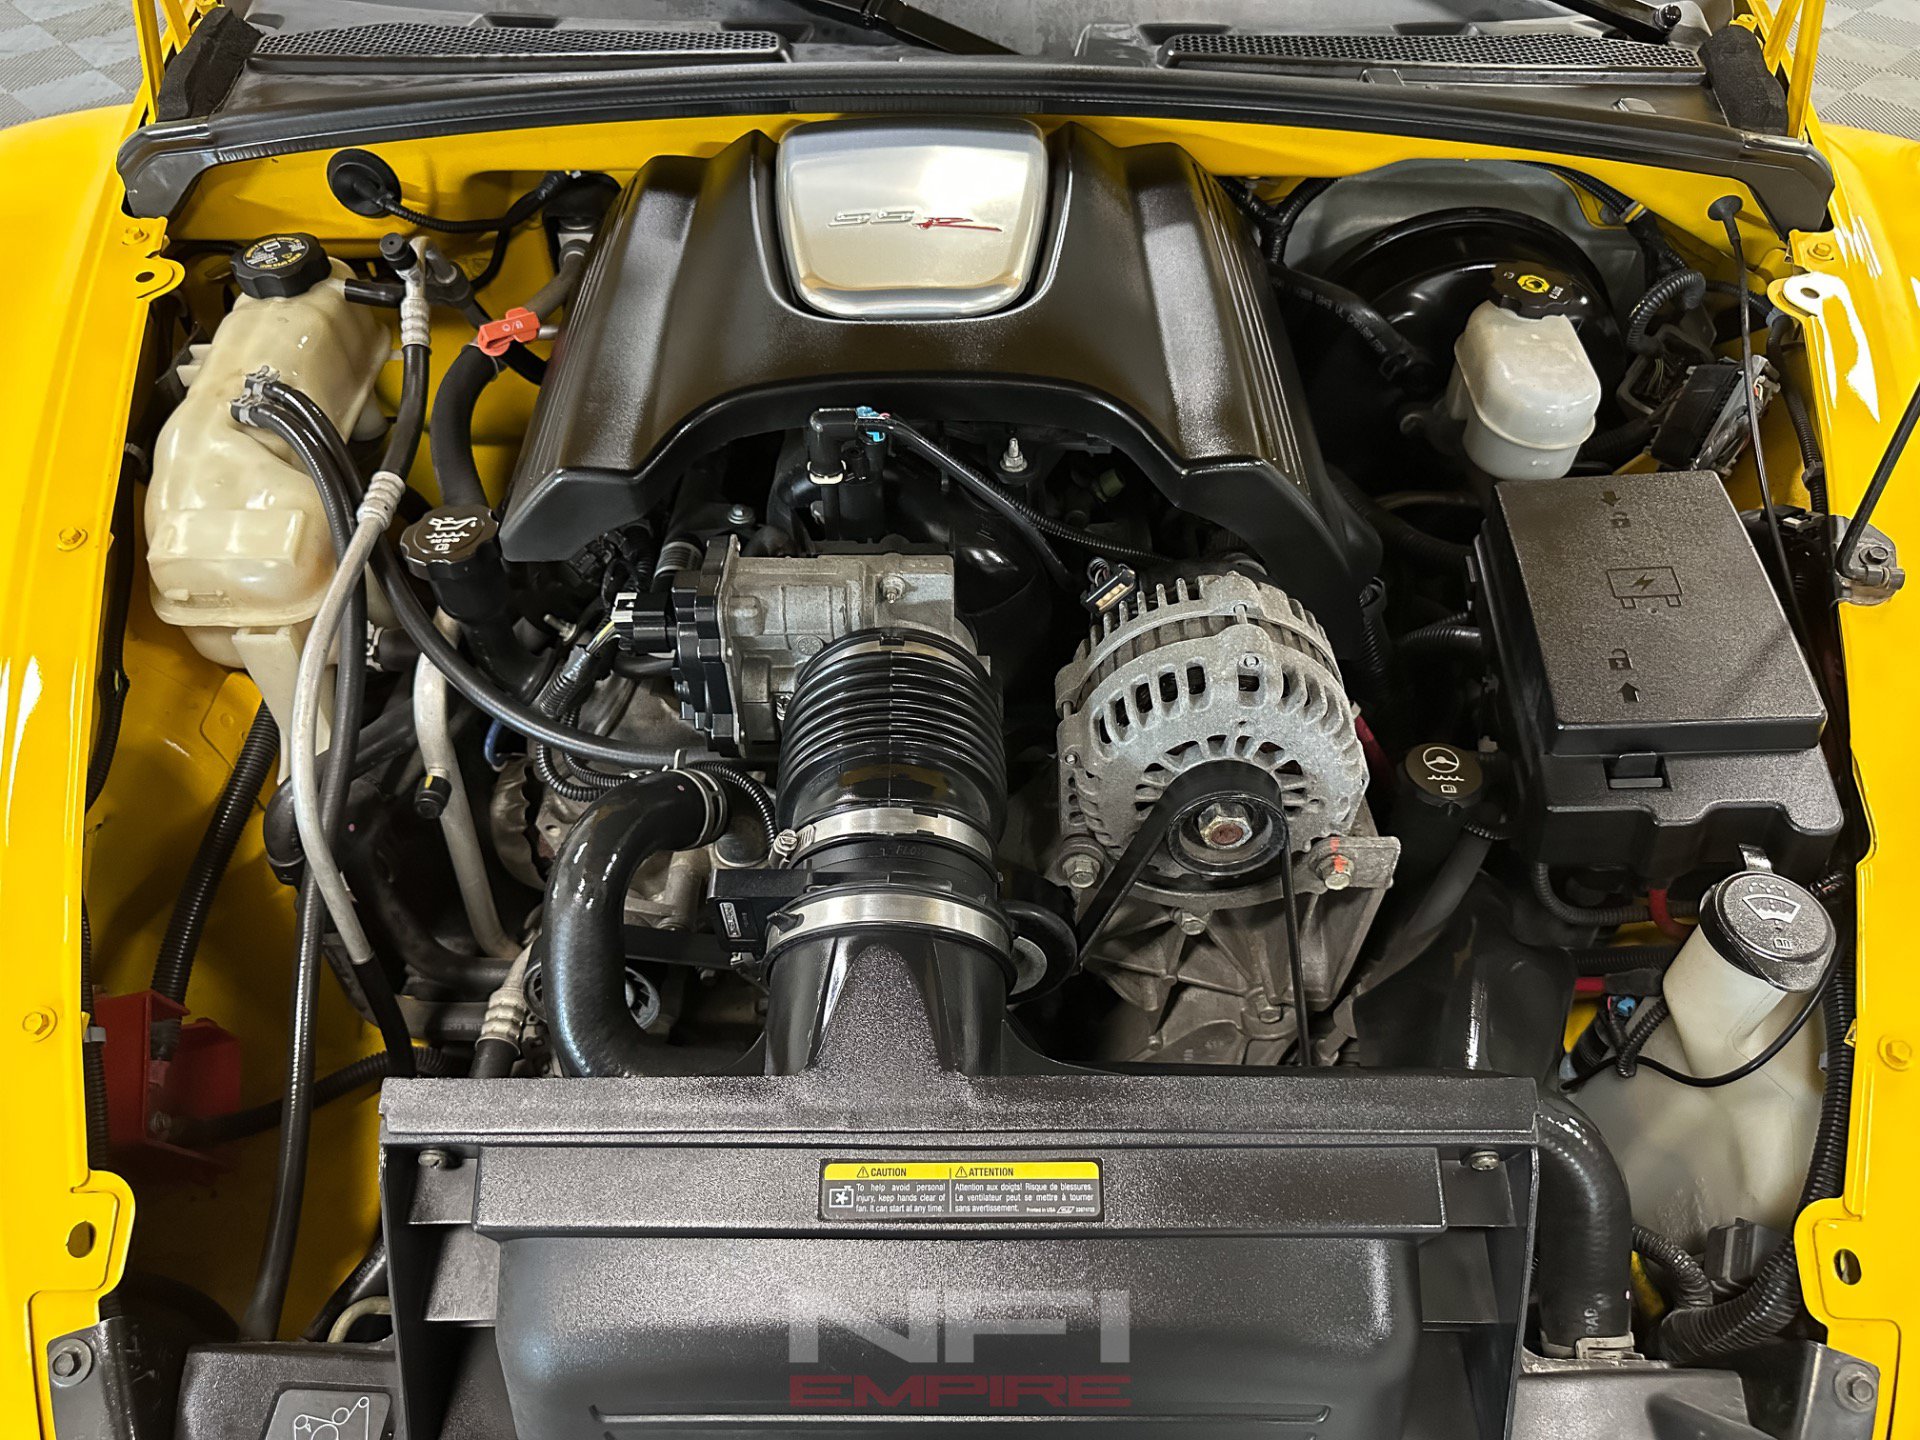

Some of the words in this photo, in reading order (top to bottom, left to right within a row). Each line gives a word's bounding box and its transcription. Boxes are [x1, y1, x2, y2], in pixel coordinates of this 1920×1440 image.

[828, 207, 1003, 232] SSR
[870, 1167, 907, 1177] CAUTION
[968, 1167, 1014, 1177] ATTENTION
[856, 1183, 865, 1192] To
[870, 1183, 886, 1193] help
[891, 1183, 911, 1192] avoid
[916, 1183, 946, 1193] personal
[954, 1182, 984, 1192] Attention
[986, 1184, 998, 1192] aux
[1000, 1182, 1022, 1193] doigts!
[1025, 1182, 1048, 1193] Risque
[1049, 1182, 1058, 1191] de
[1060, 1182, 1094, 1192] blessures.
[855, 1193, 876, 1204] injury,
[878, 1193, 894, 1204] keep
[897, 1193, 917, 1202] hands
[919, 1193, 936, 1202] clear
[938, 1193, 946, 1202] of
[954, 1193, 963, 1202] Le
[966, 1193, 1003, 1202] ventilateur
[1005, 1193, 1021, 1203] peut
[1024, 1194, 1033, 1202] se
[1036, 1193, 1058, 1202] mettre
[1061, 1192, 1067, 1201] à
[1069, 1193, 1094, 1202] tourner
[855, 1204, 868, 1213] fan.
[875, 1205, 888, 1213] can
[888, 1204, 905, 1213] start
[905, 1204, 913, 1213] at
[913, 1205, 926, 1214] any
[927, 1204, 945, 1213] time.
[954, 1204, 971, 1213] sans
[971, 1203, 1020, 1213] avertissement.
